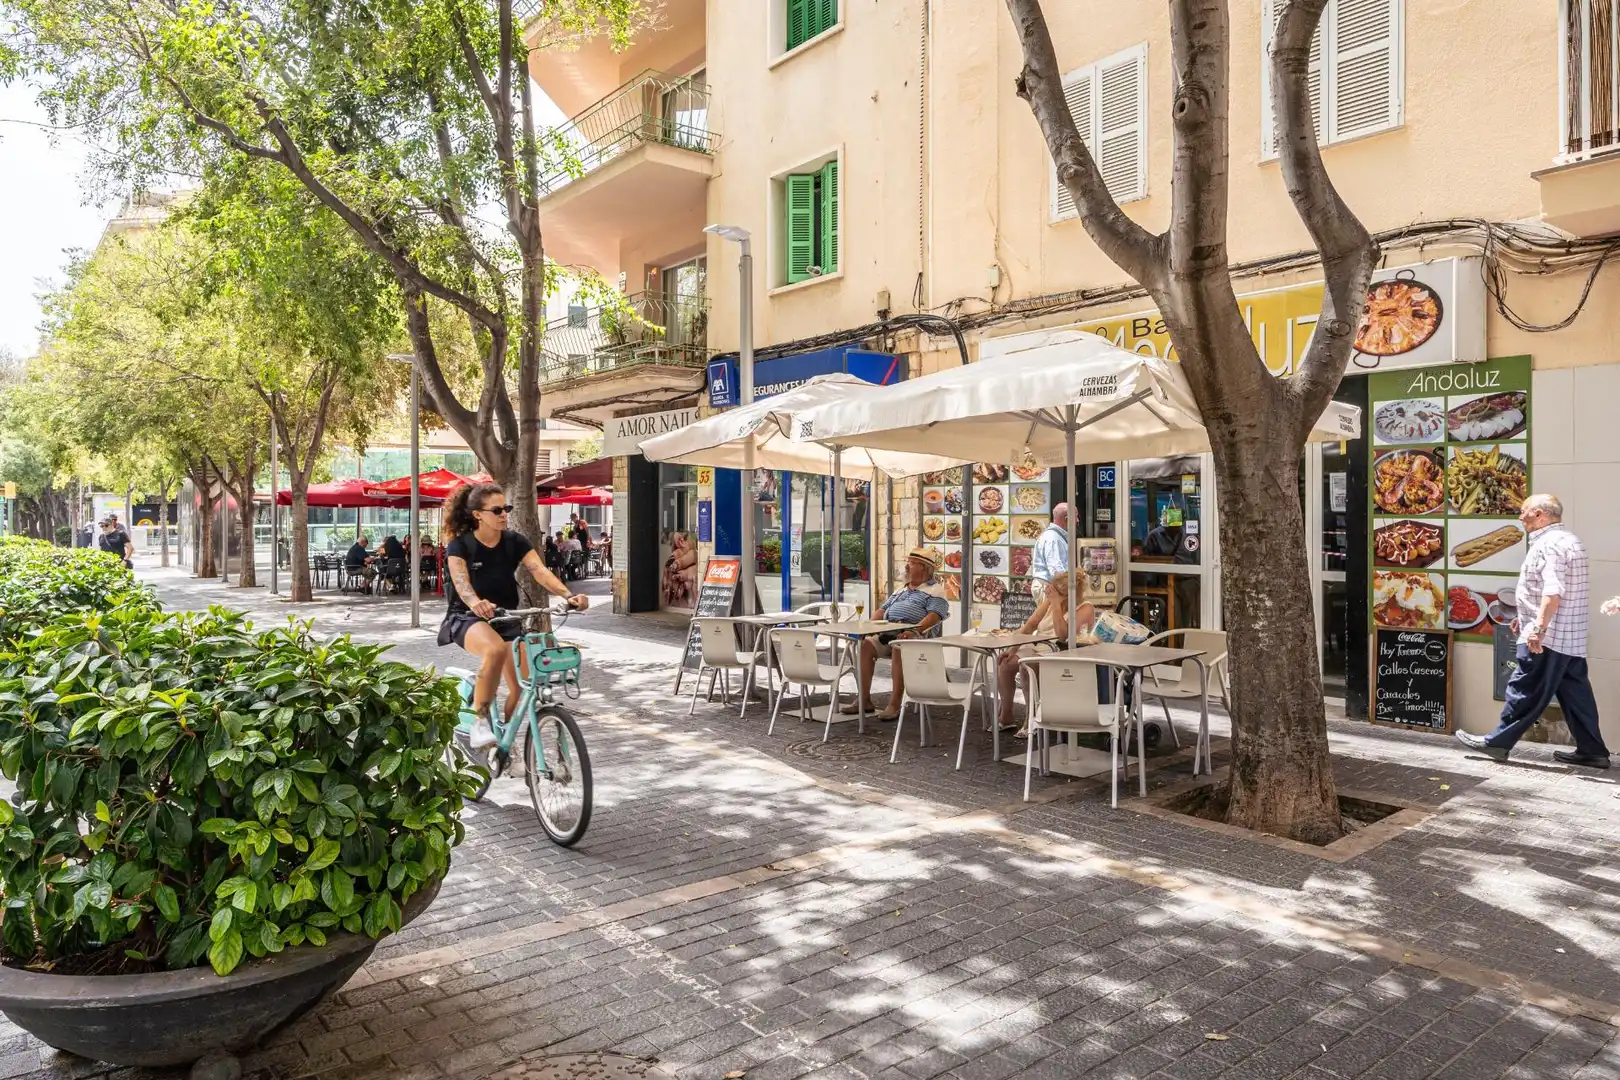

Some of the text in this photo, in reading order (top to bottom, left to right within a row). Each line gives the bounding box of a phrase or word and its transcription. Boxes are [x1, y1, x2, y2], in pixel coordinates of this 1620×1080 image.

[1132, 317, 1168, 338] Ba
[1083, 375, 1117, 386] CERVEZAS
[1406, 367, 1501, 394] Andaluz
[753, 380, 800, 397] EGURANCES
[1079, 385, 1118, 397] ALHAMBRA
[617, 416, 656, 438] AMOR
[1099, 470, 1114, 482] BC
[1378, 662, 1408, 676] Callos
